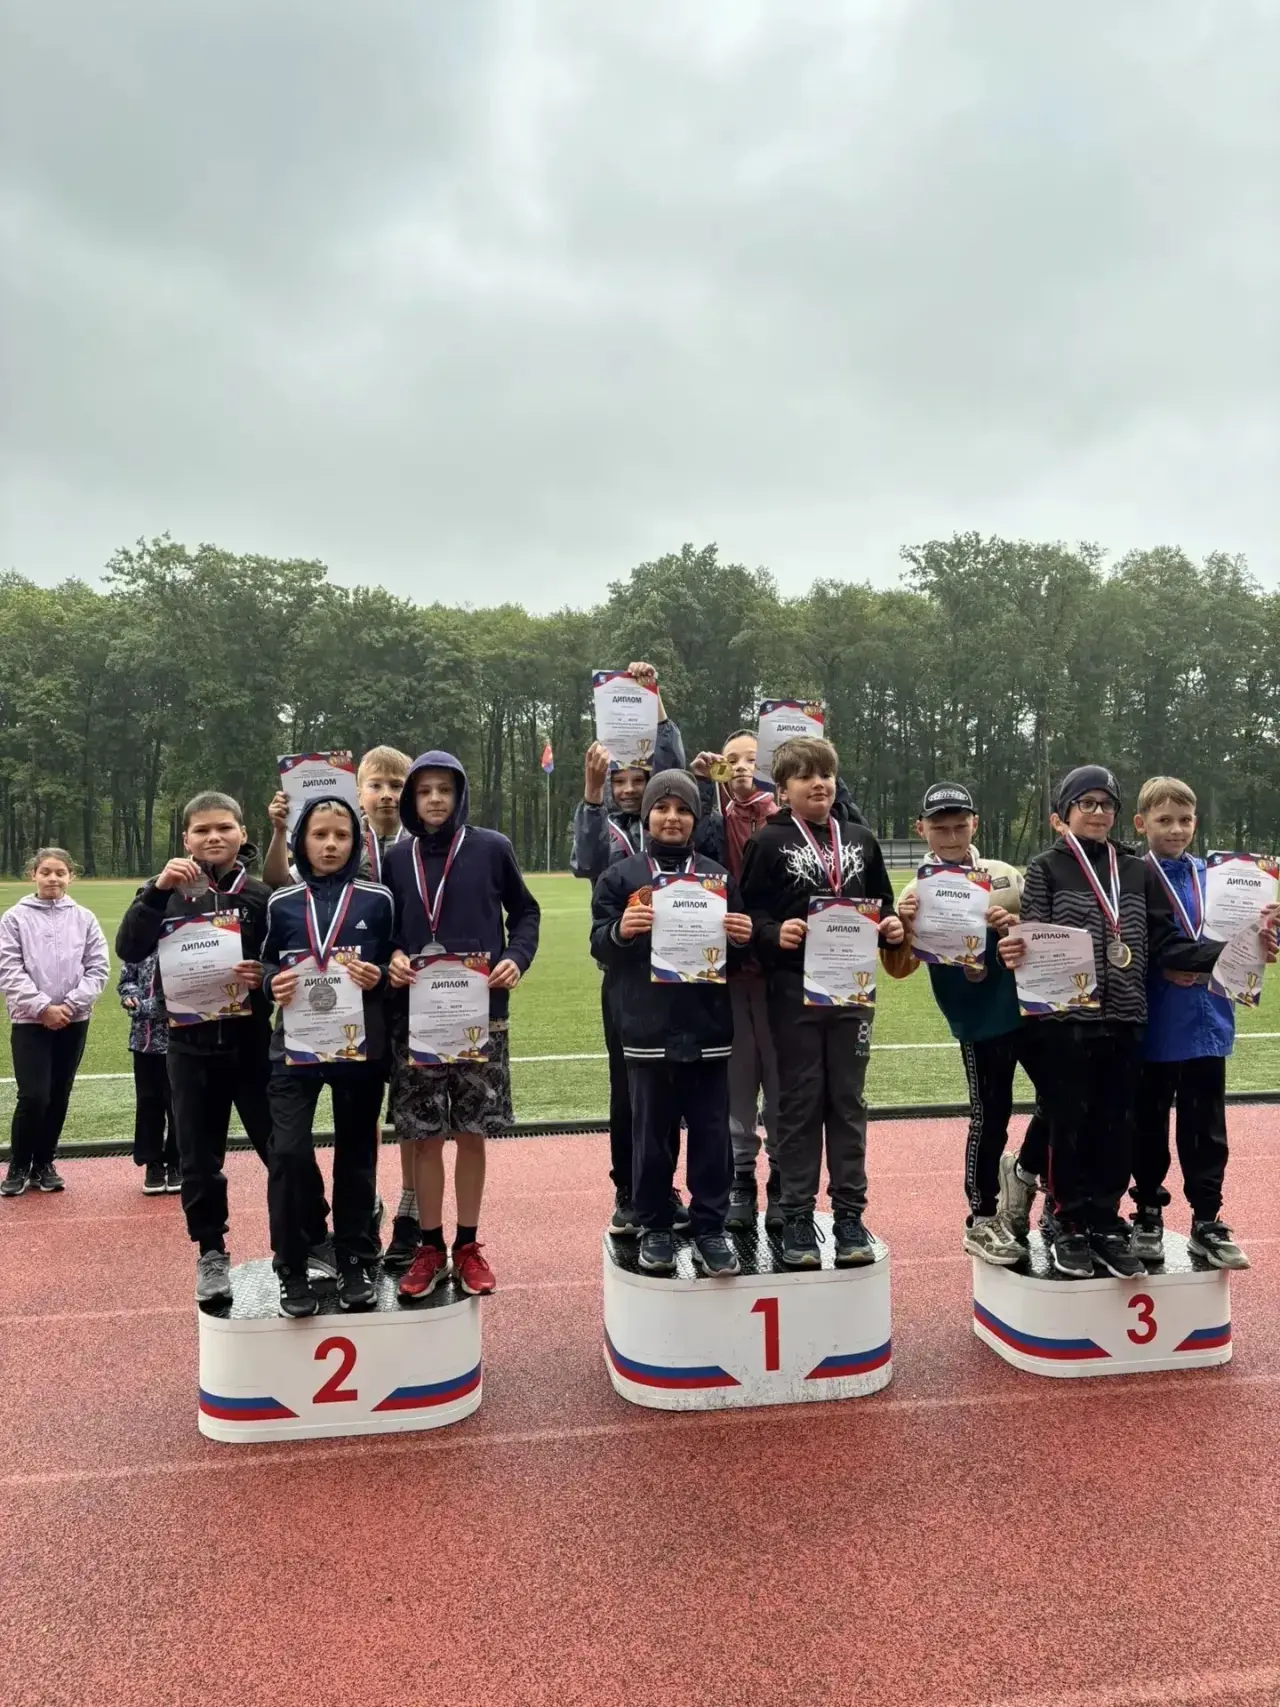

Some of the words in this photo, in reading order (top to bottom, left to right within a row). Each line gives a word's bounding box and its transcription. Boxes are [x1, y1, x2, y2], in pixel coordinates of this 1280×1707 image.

[776, 724, 807, 732] ДИПЛОМ
[302, 779, 337, 788] ДИПЛОМ
[1226, 877, 1262, 888] ДИПЛОМ
[935, 889, 971, 899] ДИПЛОМ
[672, 900, 708, 908] ДИПЛОМ
[826, 925, 861, 933] ДИПЛОМ
[1032, 932, 1070, 941] ДИПЛОМ
[180, 940, 220, 952] ДИПЛОМ
[304, 977, 342, 987] ДИПЛОМ
[431, 980, 469, 989] ДИПЛОМ
[1126, 1293, 1158, 1345] 3
[750, 1297, 780, 1371] 1
[312, 1336, 358, 1404] 2
